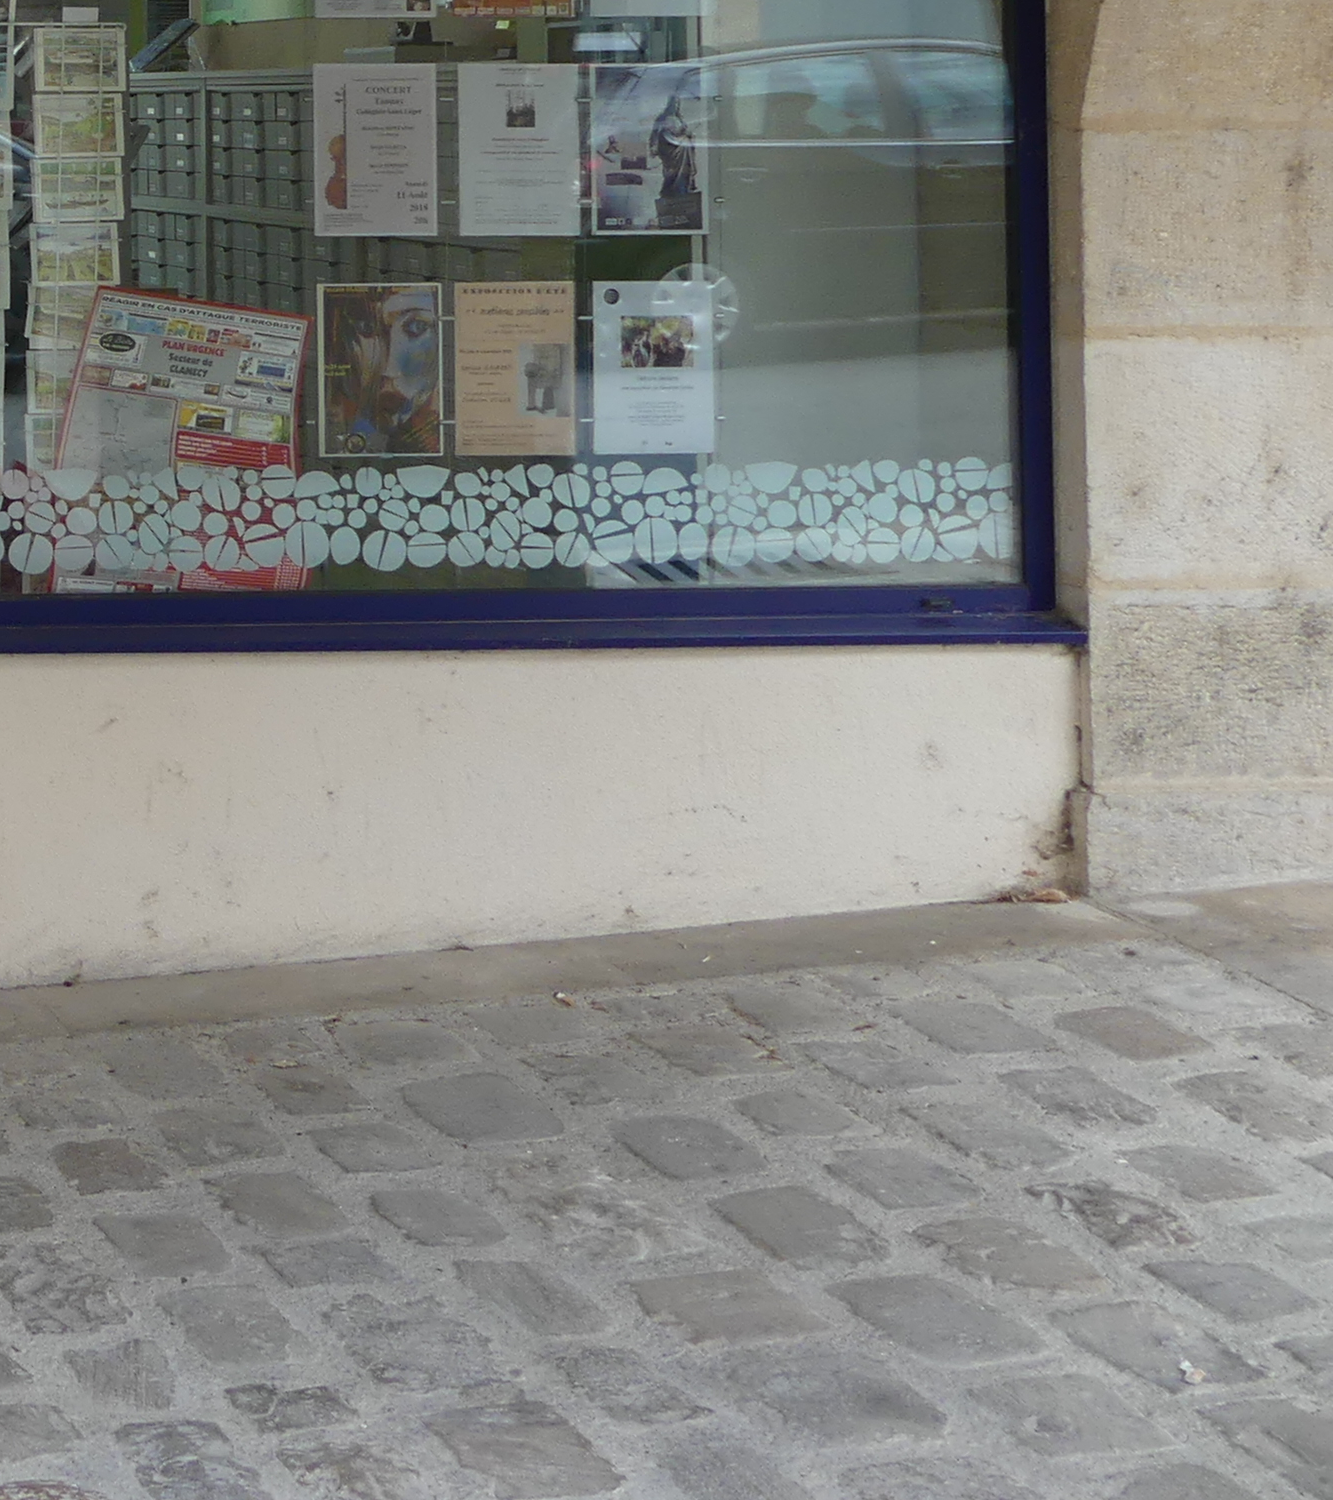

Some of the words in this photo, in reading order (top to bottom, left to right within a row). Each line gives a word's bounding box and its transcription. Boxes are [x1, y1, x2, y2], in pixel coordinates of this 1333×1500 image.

[364, 86, 412, 94] CONCERT
[101, 295, 140, 308] RÉAGIR
[140, 302, 156, 311] EN
[156, 304, 177, 315] CAS
[179, 308, 235, 321] D'ATTAQUE
[238, 316, 303, 332] TERRORISTE
[162, 340, 186, 351] PLAN
[186, 342, 226, 358] URGENCE
[169, 364, 209, 379] CLAMECY
